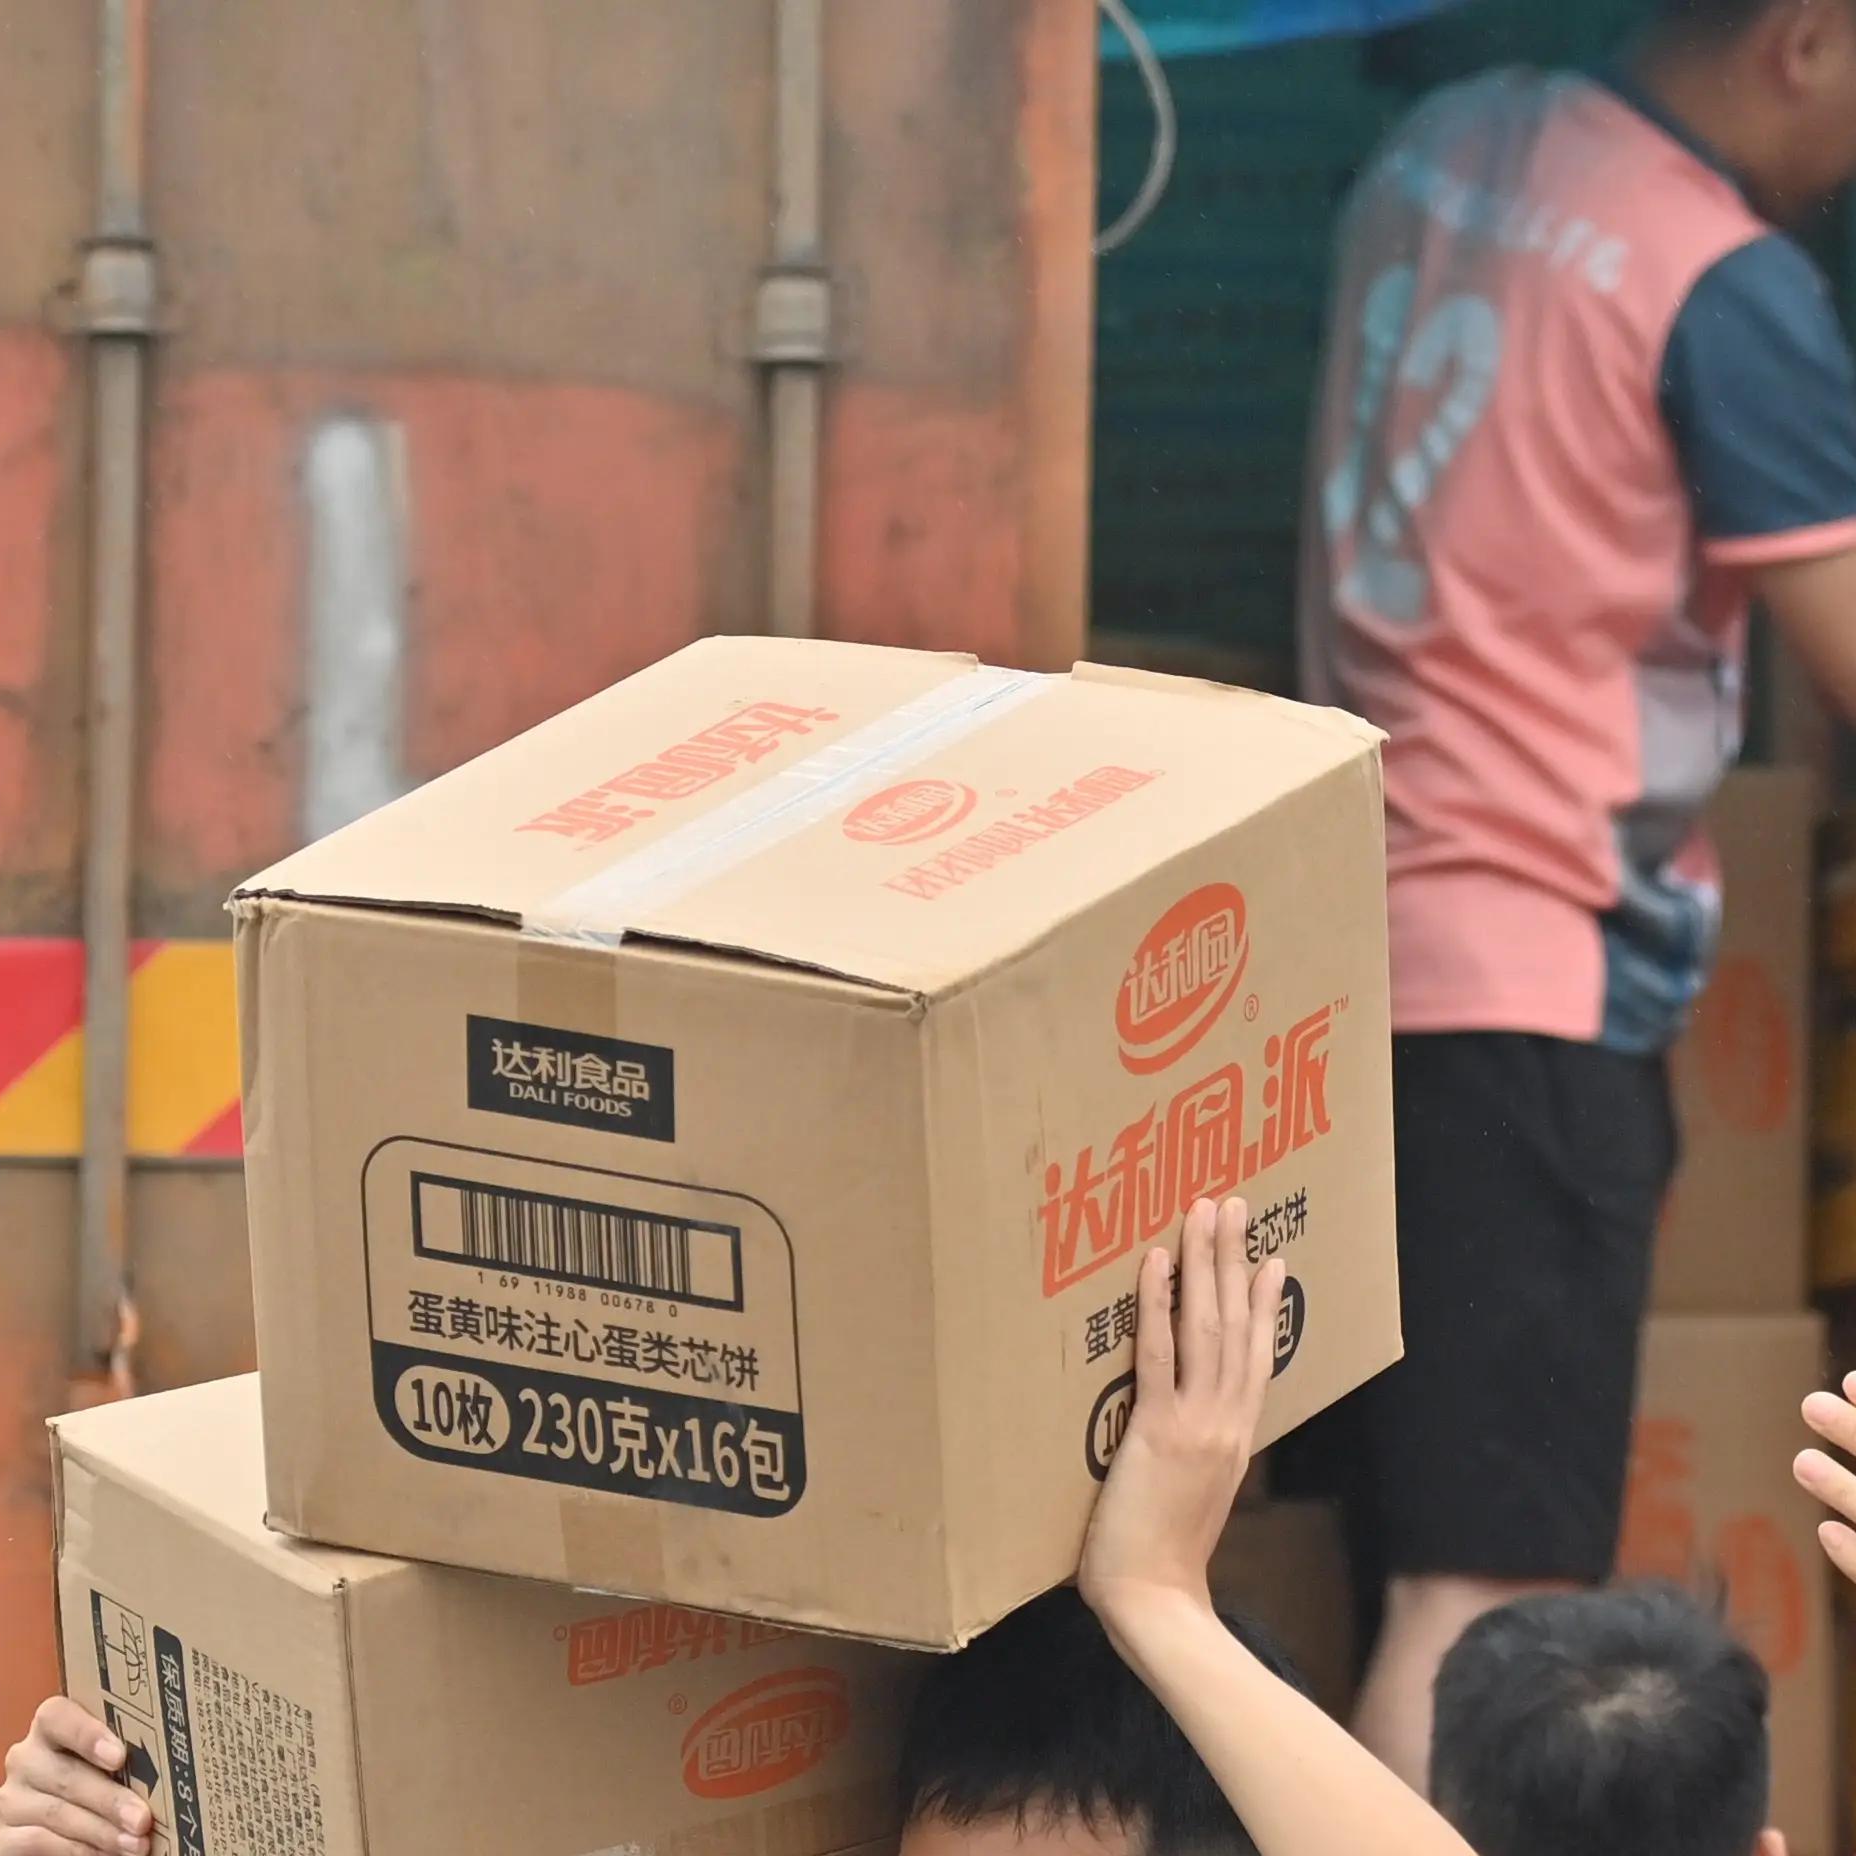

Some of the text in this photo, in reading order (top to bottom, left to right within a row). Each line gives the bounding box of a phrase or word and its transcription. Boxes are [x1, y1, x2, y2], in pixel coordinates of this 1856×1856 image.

[1124, 907, 1237, 1023] 达利园
[492, 1038, 650, 1101] 达利食品
[508, 1081, 632, 1118] DALI FOODS
[498, 1274, 520, 1290] 69
[533, 1280, 587, 1302] 11988
[407, 1289, 760, 1393] 蛋黄味注心蛋类芯饼
[411, 1376, 791, 1502] 10枚 230克x16包
[700, 1708, 836, 1780] 达利园
